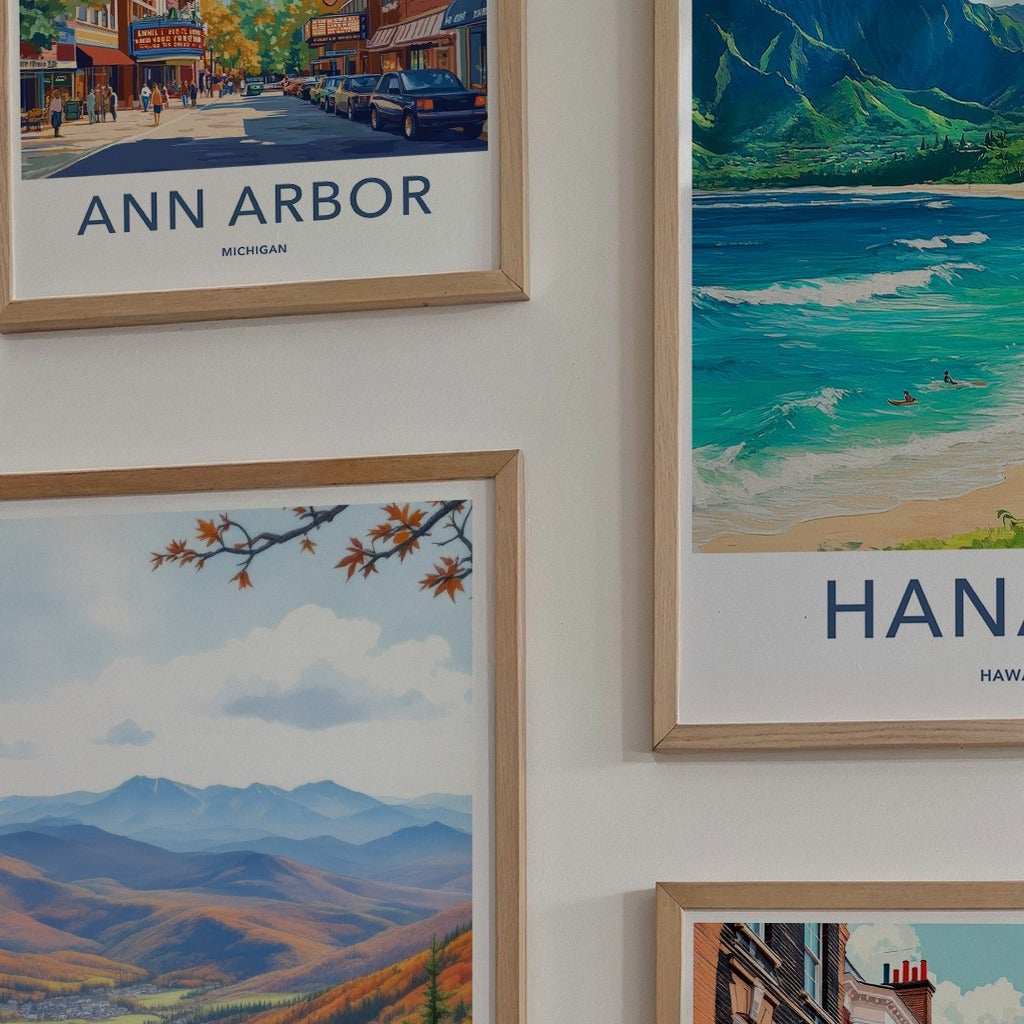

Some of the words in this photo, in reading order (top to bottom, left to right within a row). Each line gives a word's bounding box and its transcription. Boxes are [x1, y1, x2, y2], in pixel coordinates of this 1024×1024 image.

[77, 188, 204, 236] ANN
[227, 175, 432, 227] ARBOR
[221, 242, 288, 257] MICHIGAN
[827, 577, 1024, 639] HAN
[980, 668, 1024, 682] HAW
